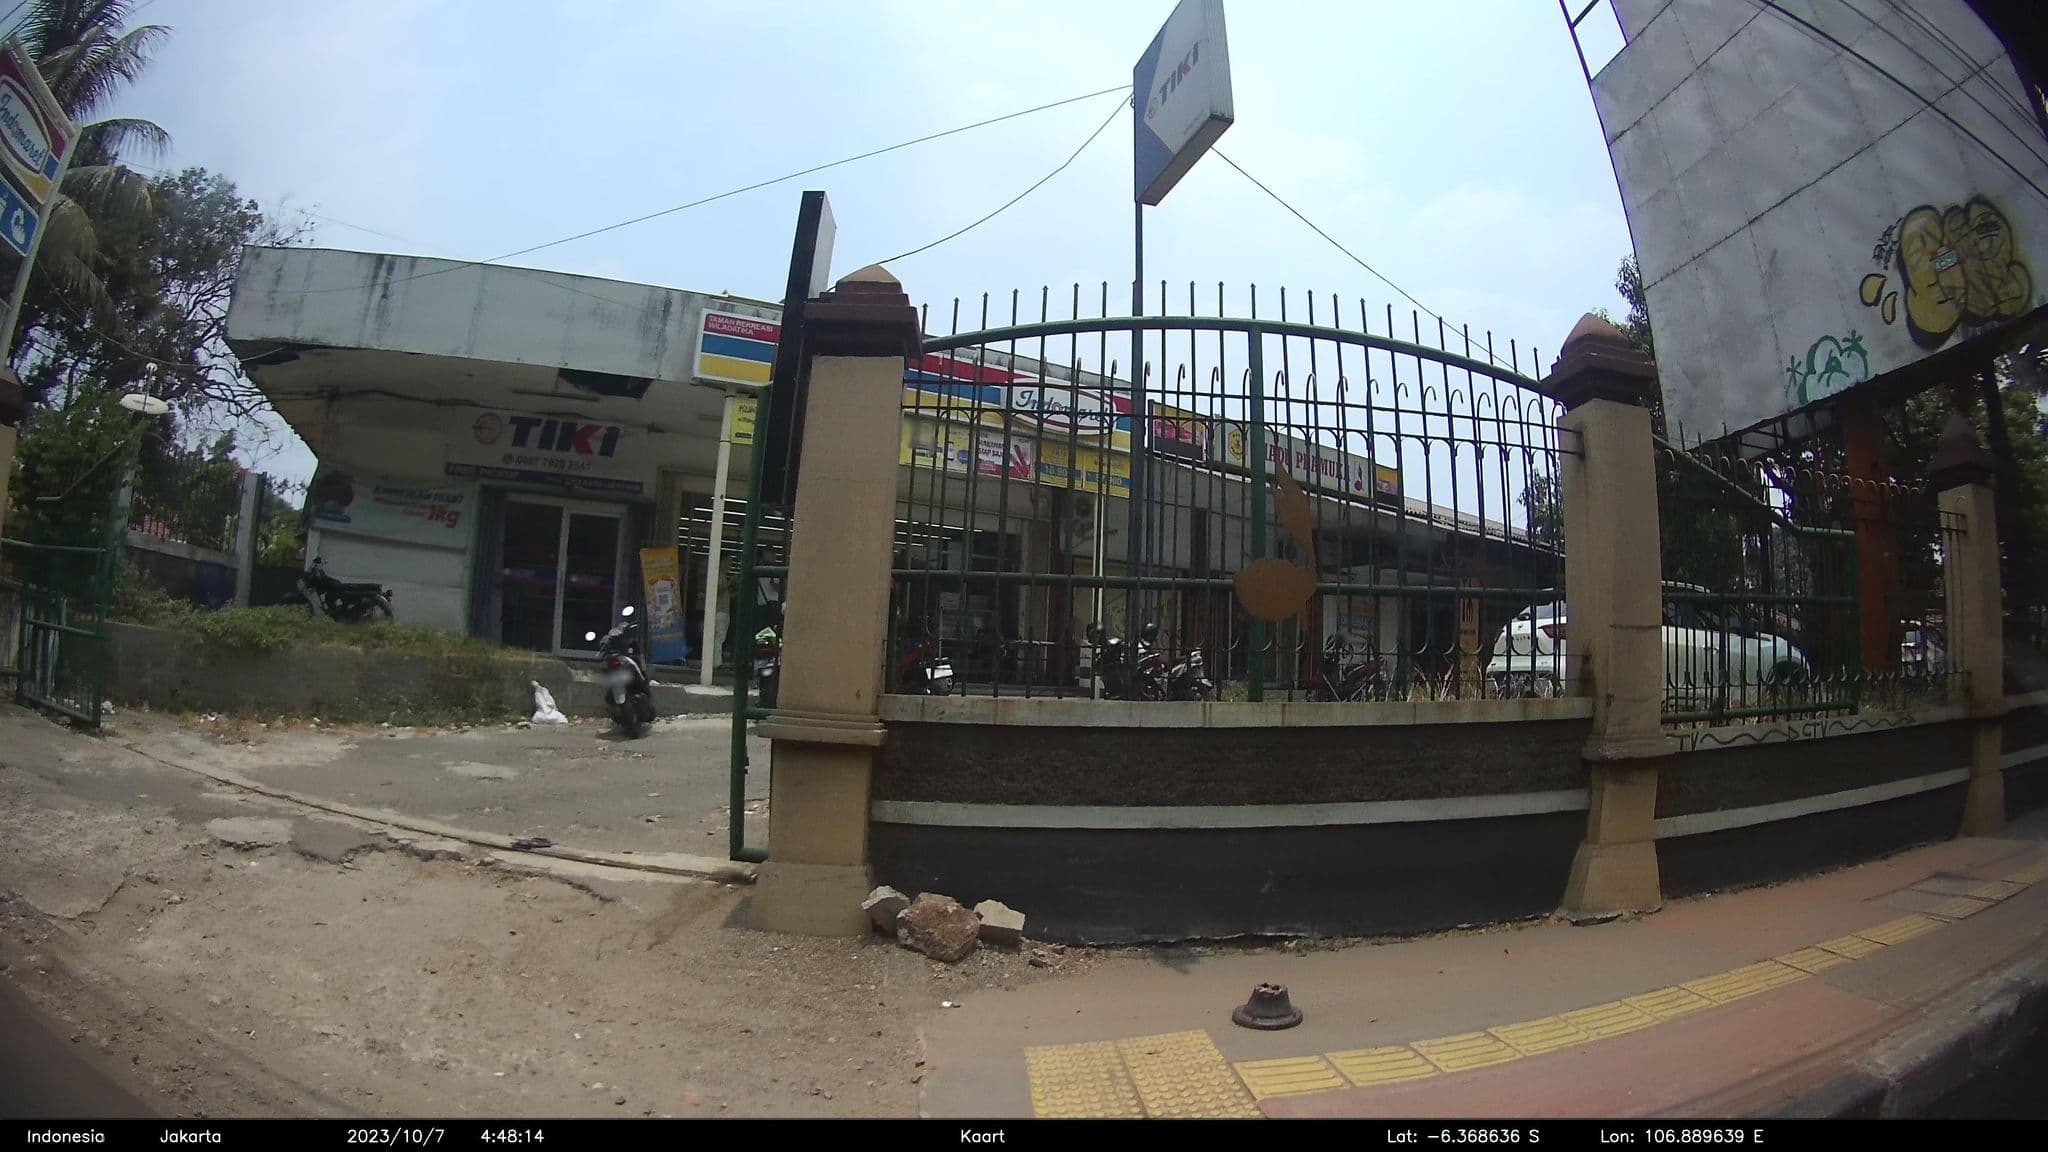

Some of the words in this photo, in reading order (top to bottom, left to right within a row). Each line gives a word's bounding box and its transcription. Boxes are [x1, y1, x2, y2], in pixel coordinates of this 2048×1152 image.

[1159, 39, 1201, 105] TIKI
[0, 93, 45, 167] Indomaret
[708, 315, 736, 326] TAMAN
[735, 320, 774, 332] REKREASI
[509, 416, 621, 457] TIKI
[1295, 451, 1349, 482] PRAMUK
